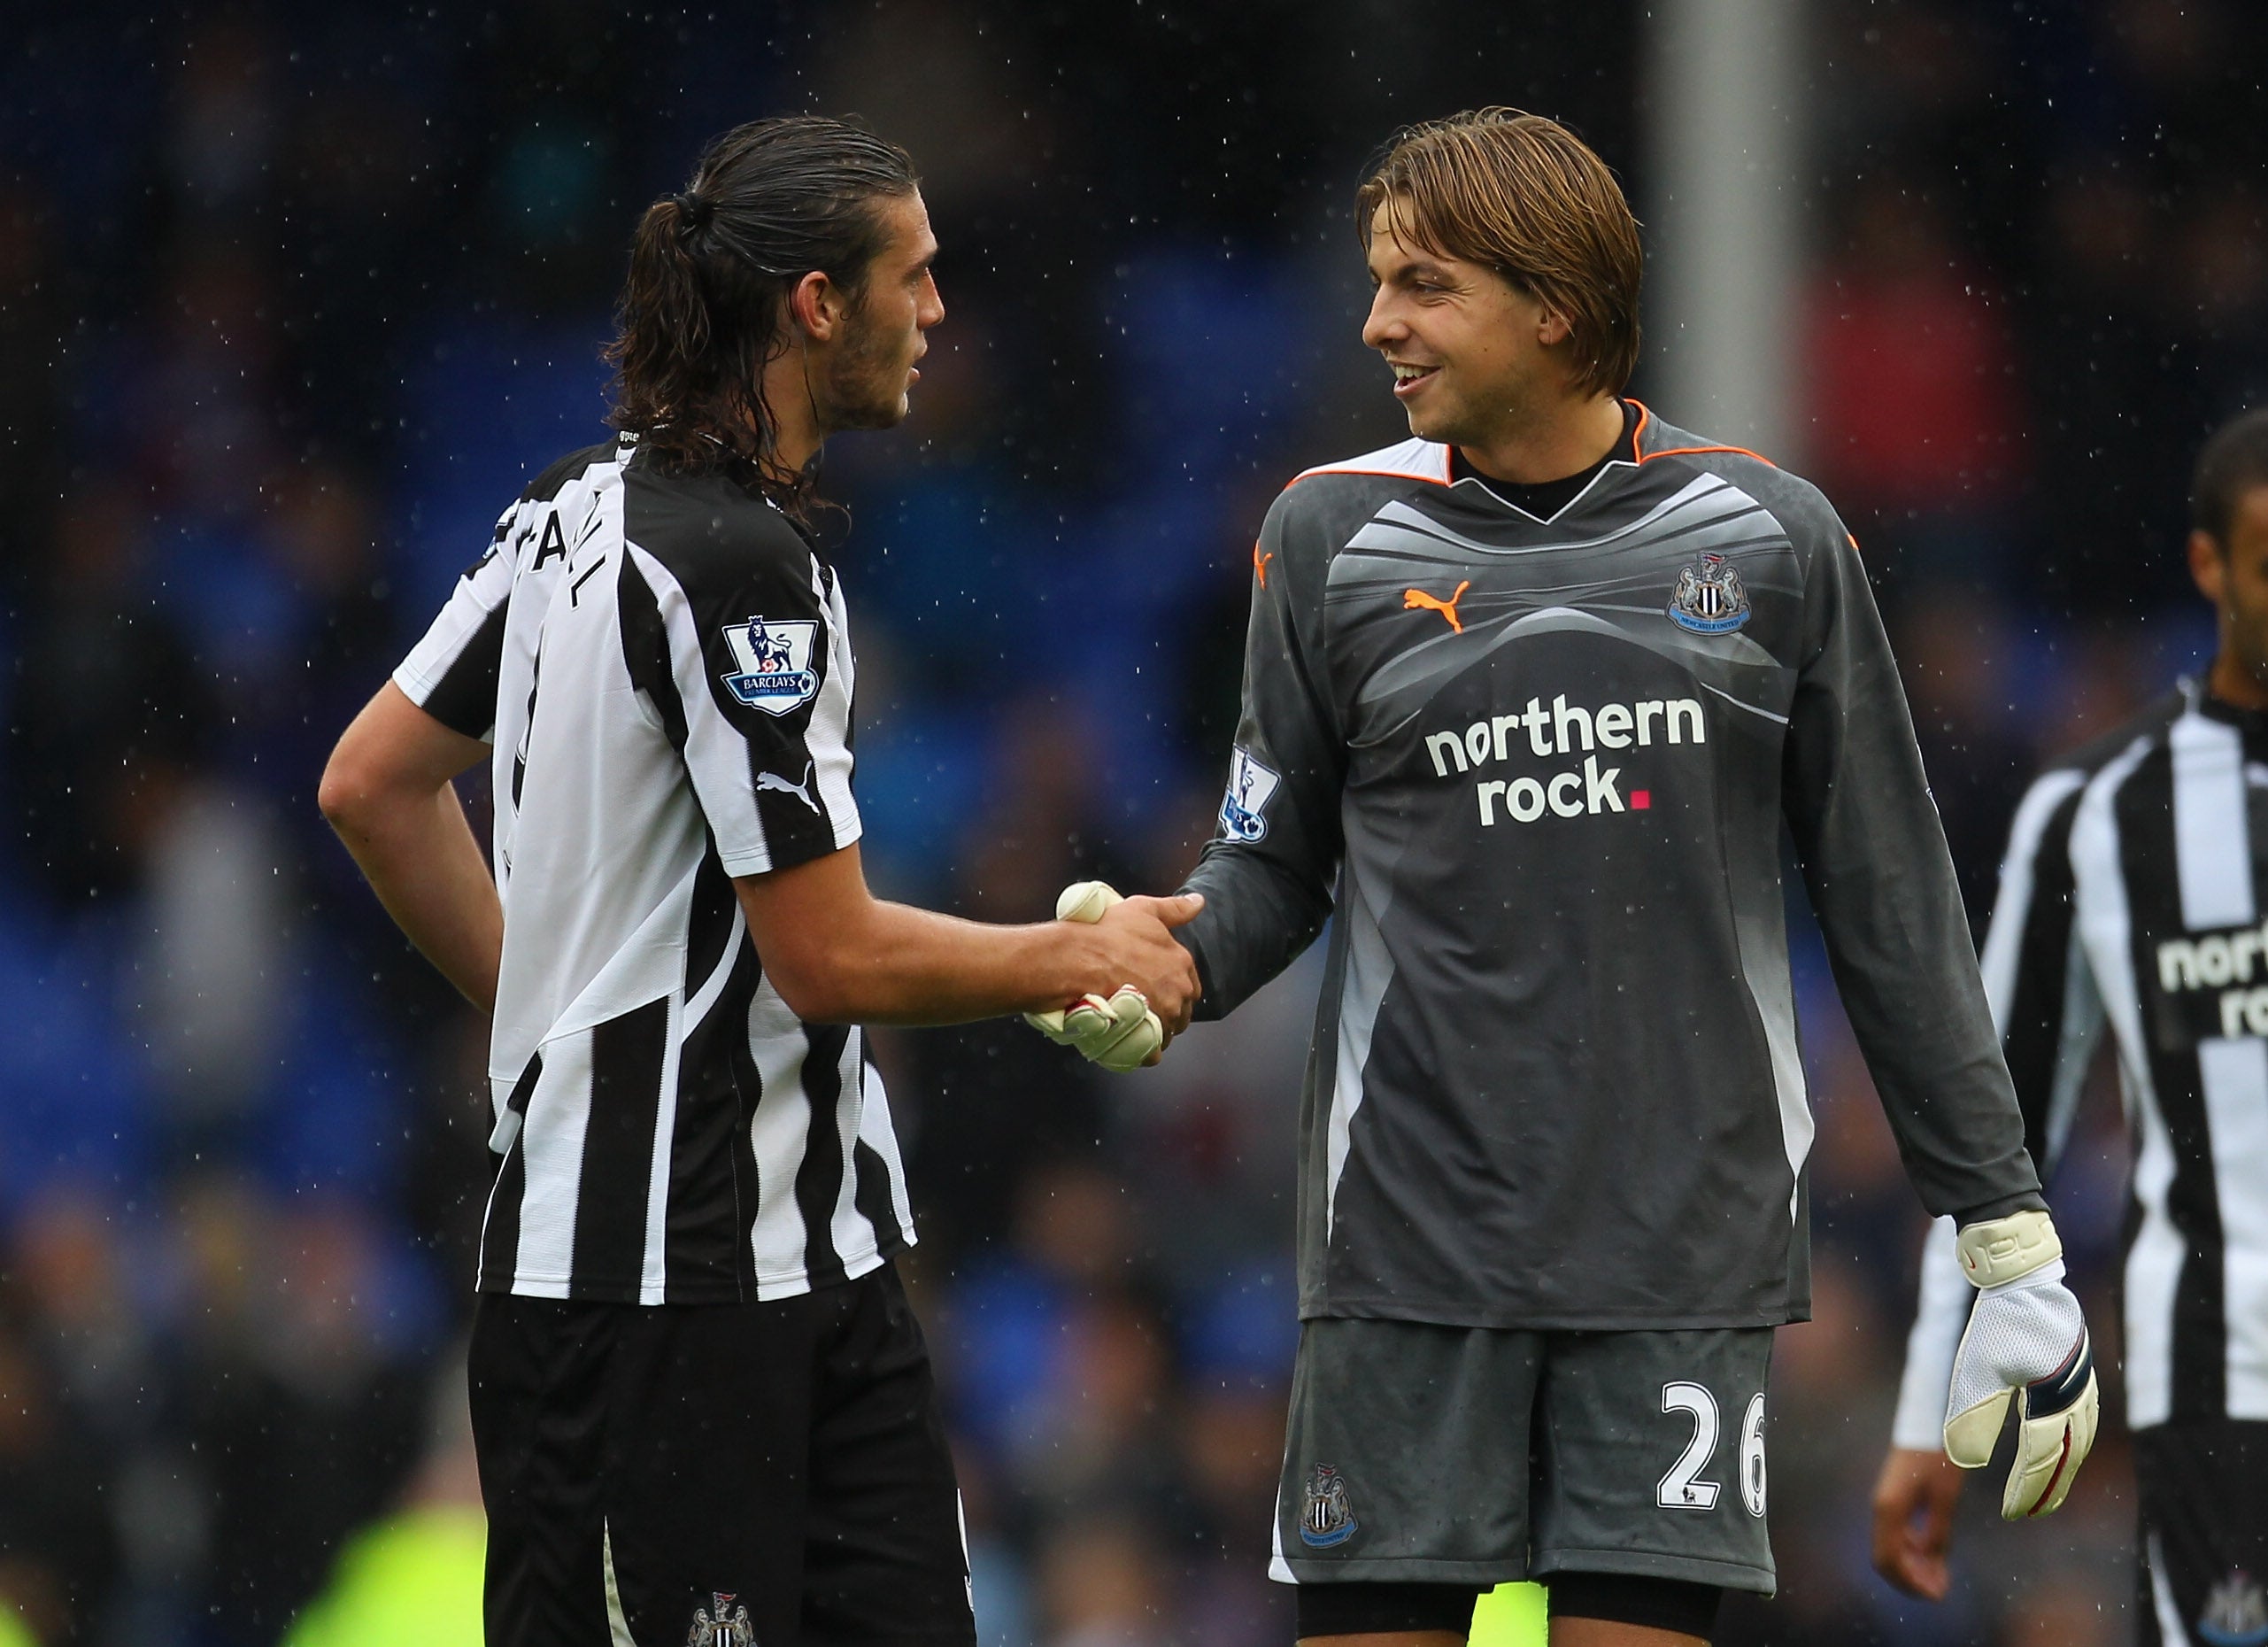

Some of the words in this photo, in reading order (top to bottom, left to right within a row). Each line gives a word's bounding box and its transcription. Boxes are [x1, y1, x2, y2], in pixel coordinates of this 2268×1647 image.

[1717, 618, 1740, 630] UNITED
[744, 676, 796, 690] BARCLAYS
[1424, 693, 1706, 777] northern
[1657, 1380, 1767, 1518] 26
